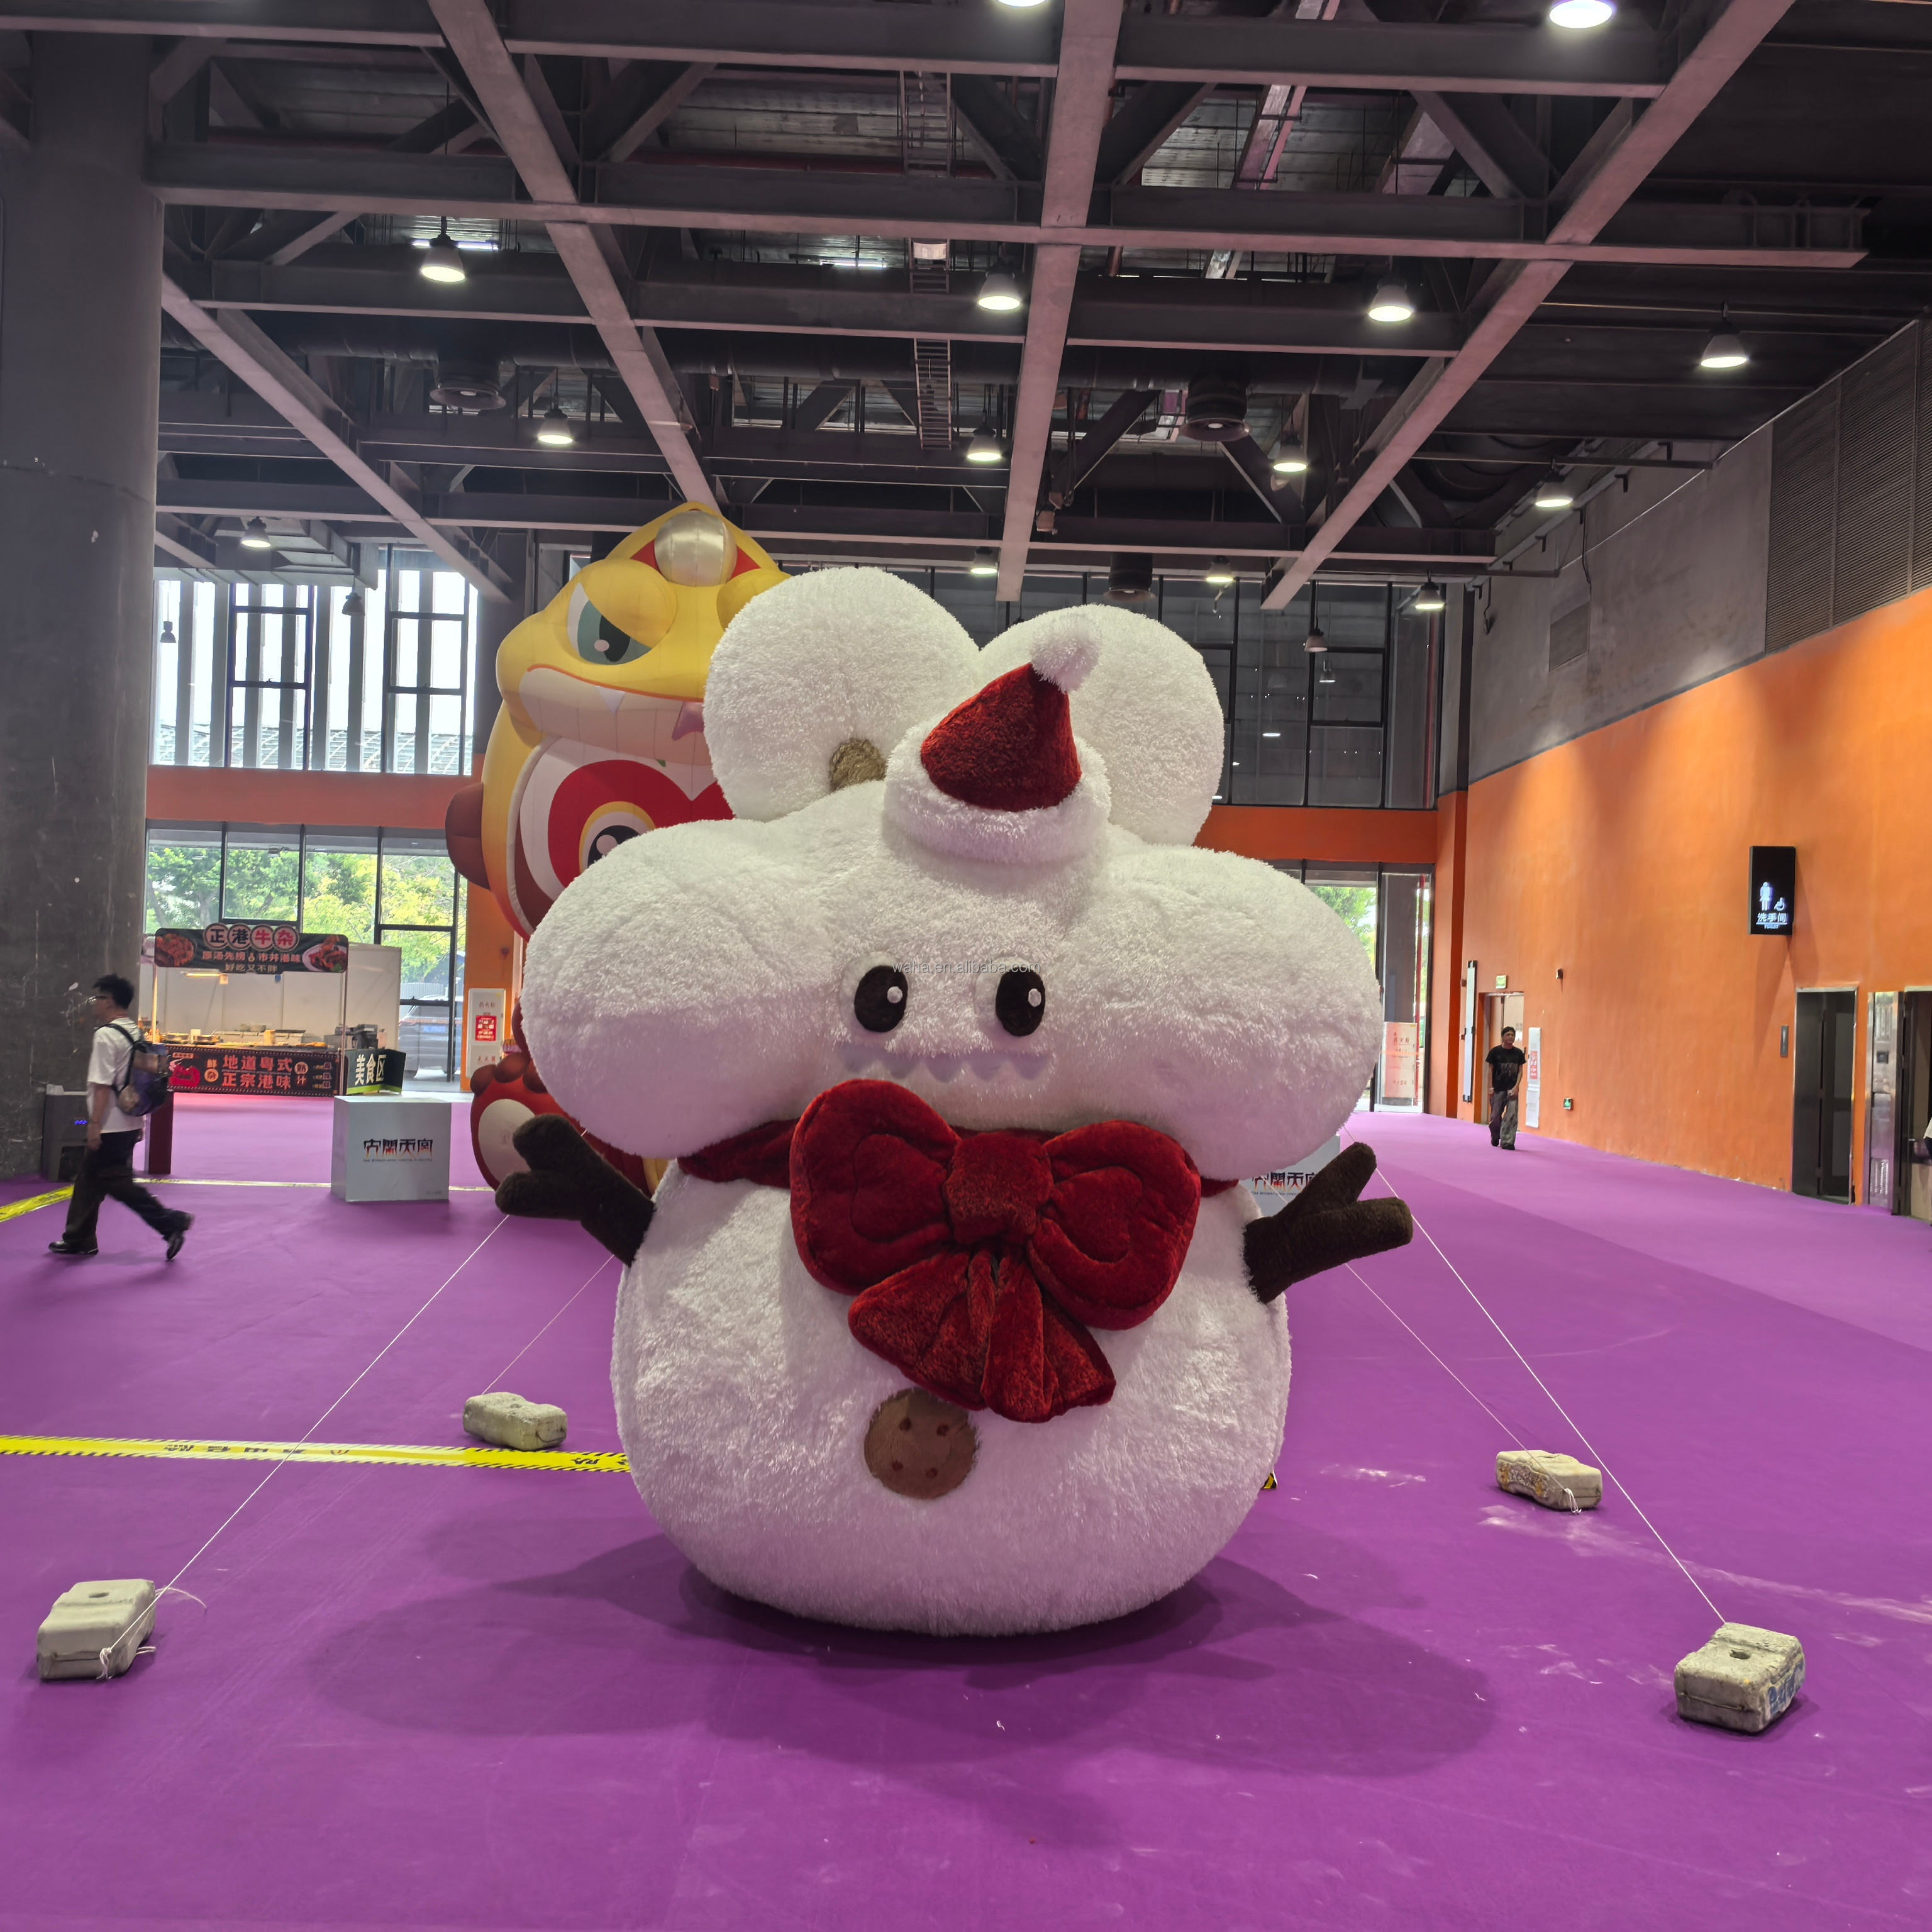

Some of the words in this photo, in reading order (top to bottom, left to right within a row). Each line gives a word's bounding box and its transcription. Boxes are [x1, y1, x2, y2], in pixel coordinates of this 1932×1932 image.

[1757, 912, 1787, 923] 洗手间
[209, 928, 294, 947] 正港牛杂
[223, 1054, 292, 1072] 地道粤式
[355, 1053, 387, 1085] 美食区
[221, 1072, 292, 1090] 正宗港味
